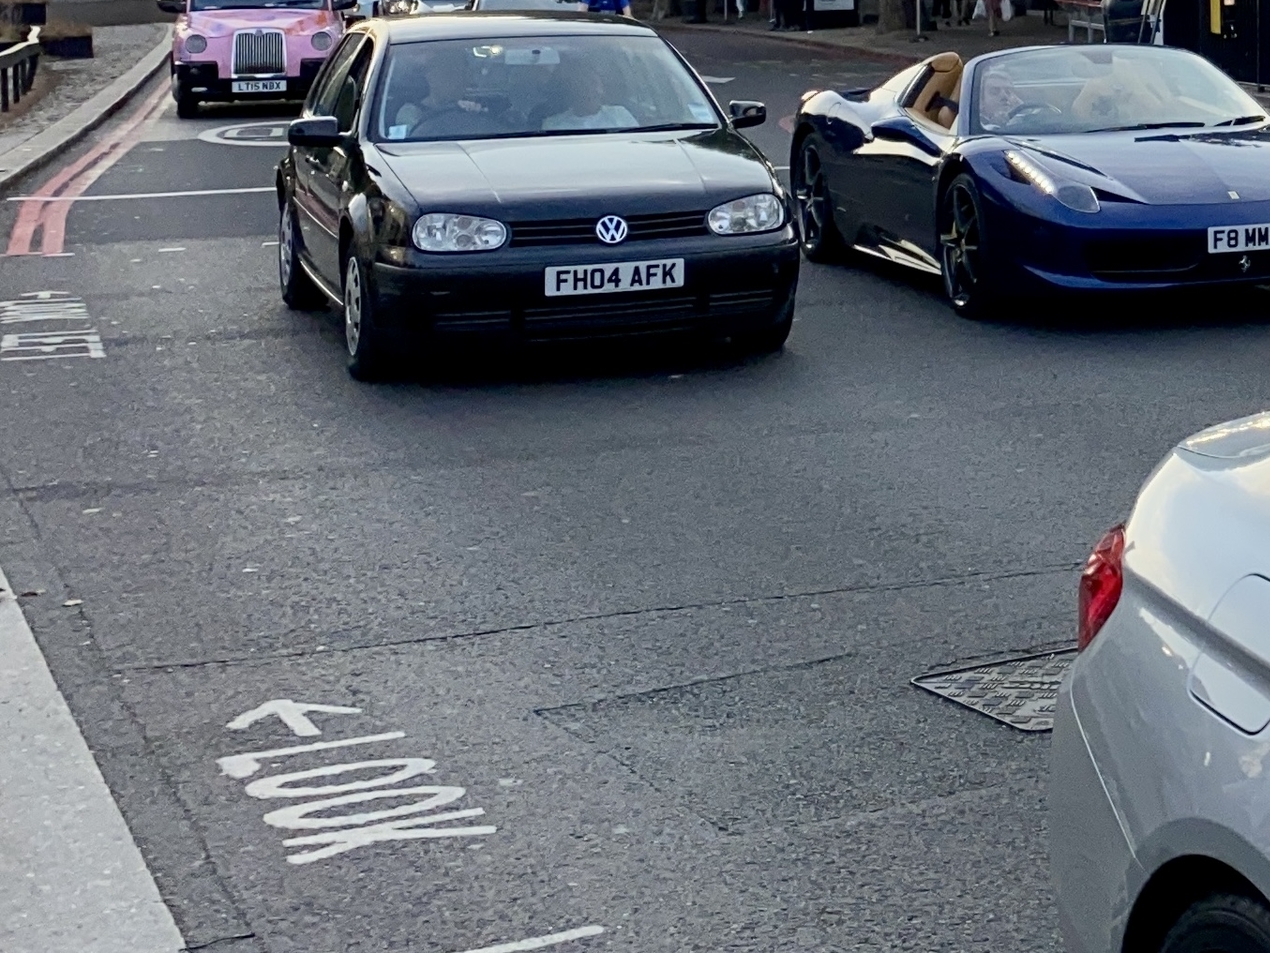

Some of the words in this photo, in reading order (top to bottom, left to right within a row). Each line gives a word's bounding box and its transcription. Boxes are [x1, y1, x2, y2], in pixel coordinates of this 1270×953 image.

[1212, 229, 1239, 250] F8
[555, 266, 622, 292] FH04
[629, 262, 677, 287] AFK
[215, 731, 497, 865] LOOK
